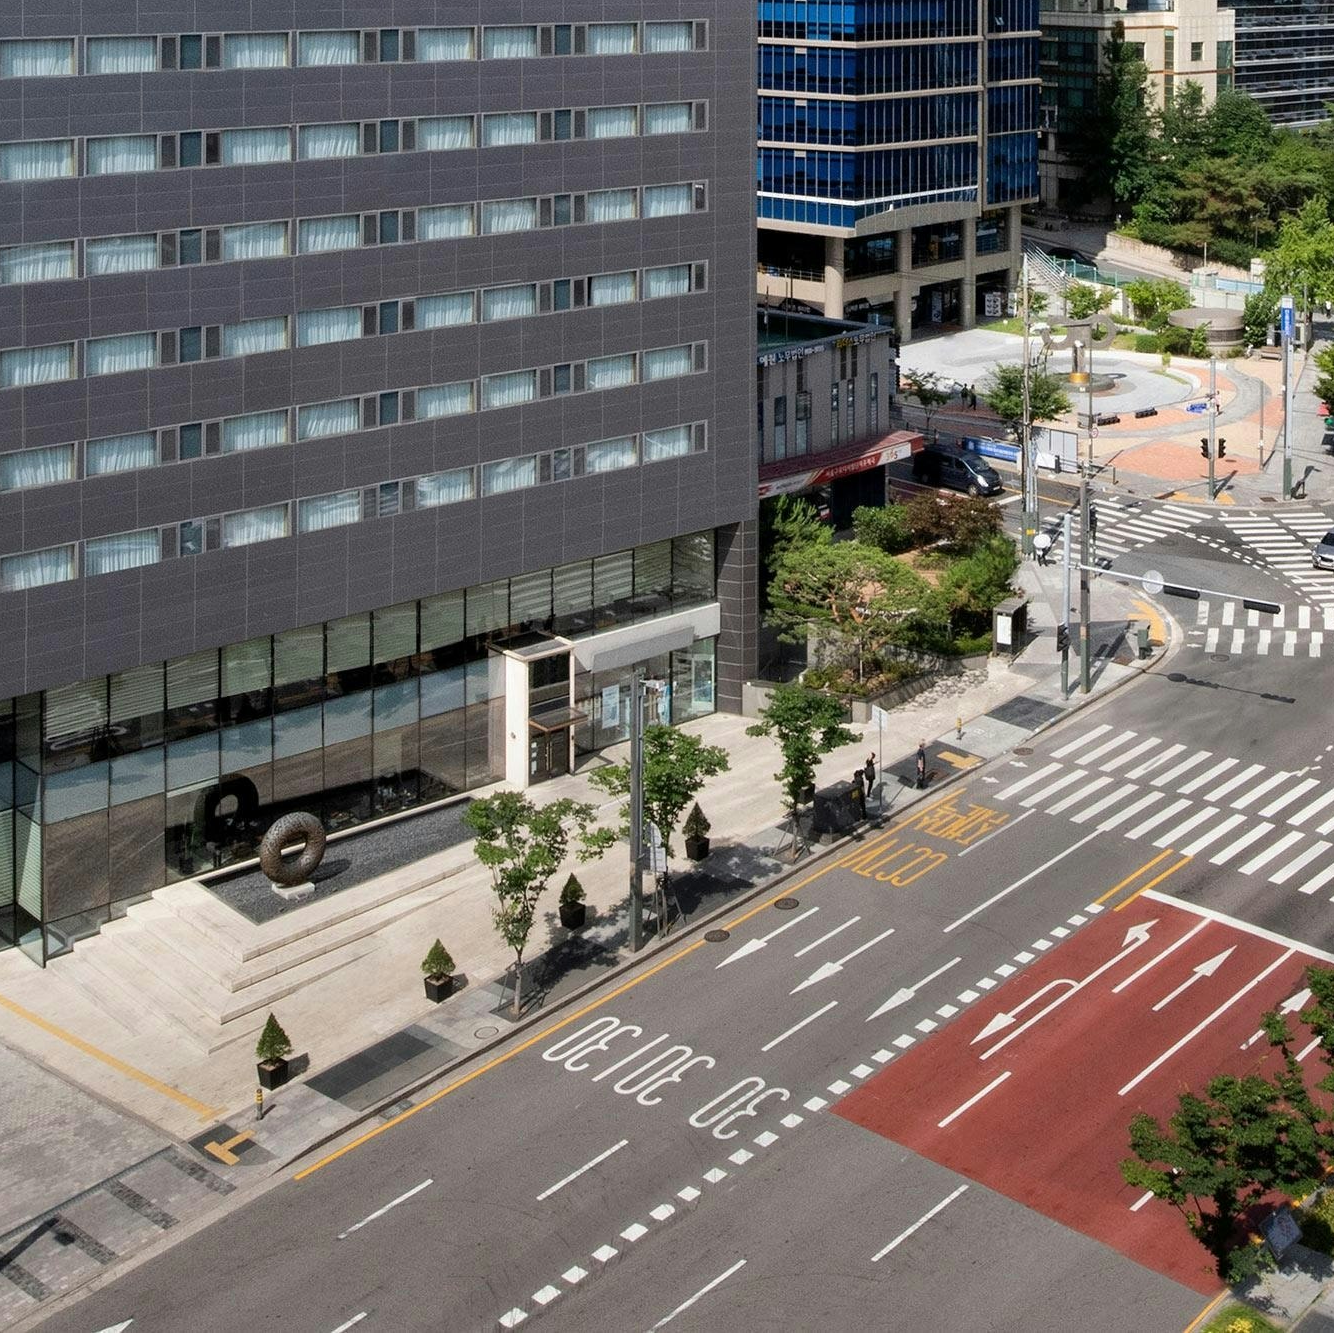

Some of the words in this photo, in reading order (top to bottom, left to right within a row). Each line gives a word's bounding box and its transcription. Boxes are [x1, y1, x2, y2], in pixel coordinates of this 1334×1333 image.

[840, 838, 948, 888] CCTV
[542, 1016, 643, 1072] 30
[613, 1045, 716, 1105] 30
[689, 1076, 791, 1140] 30
